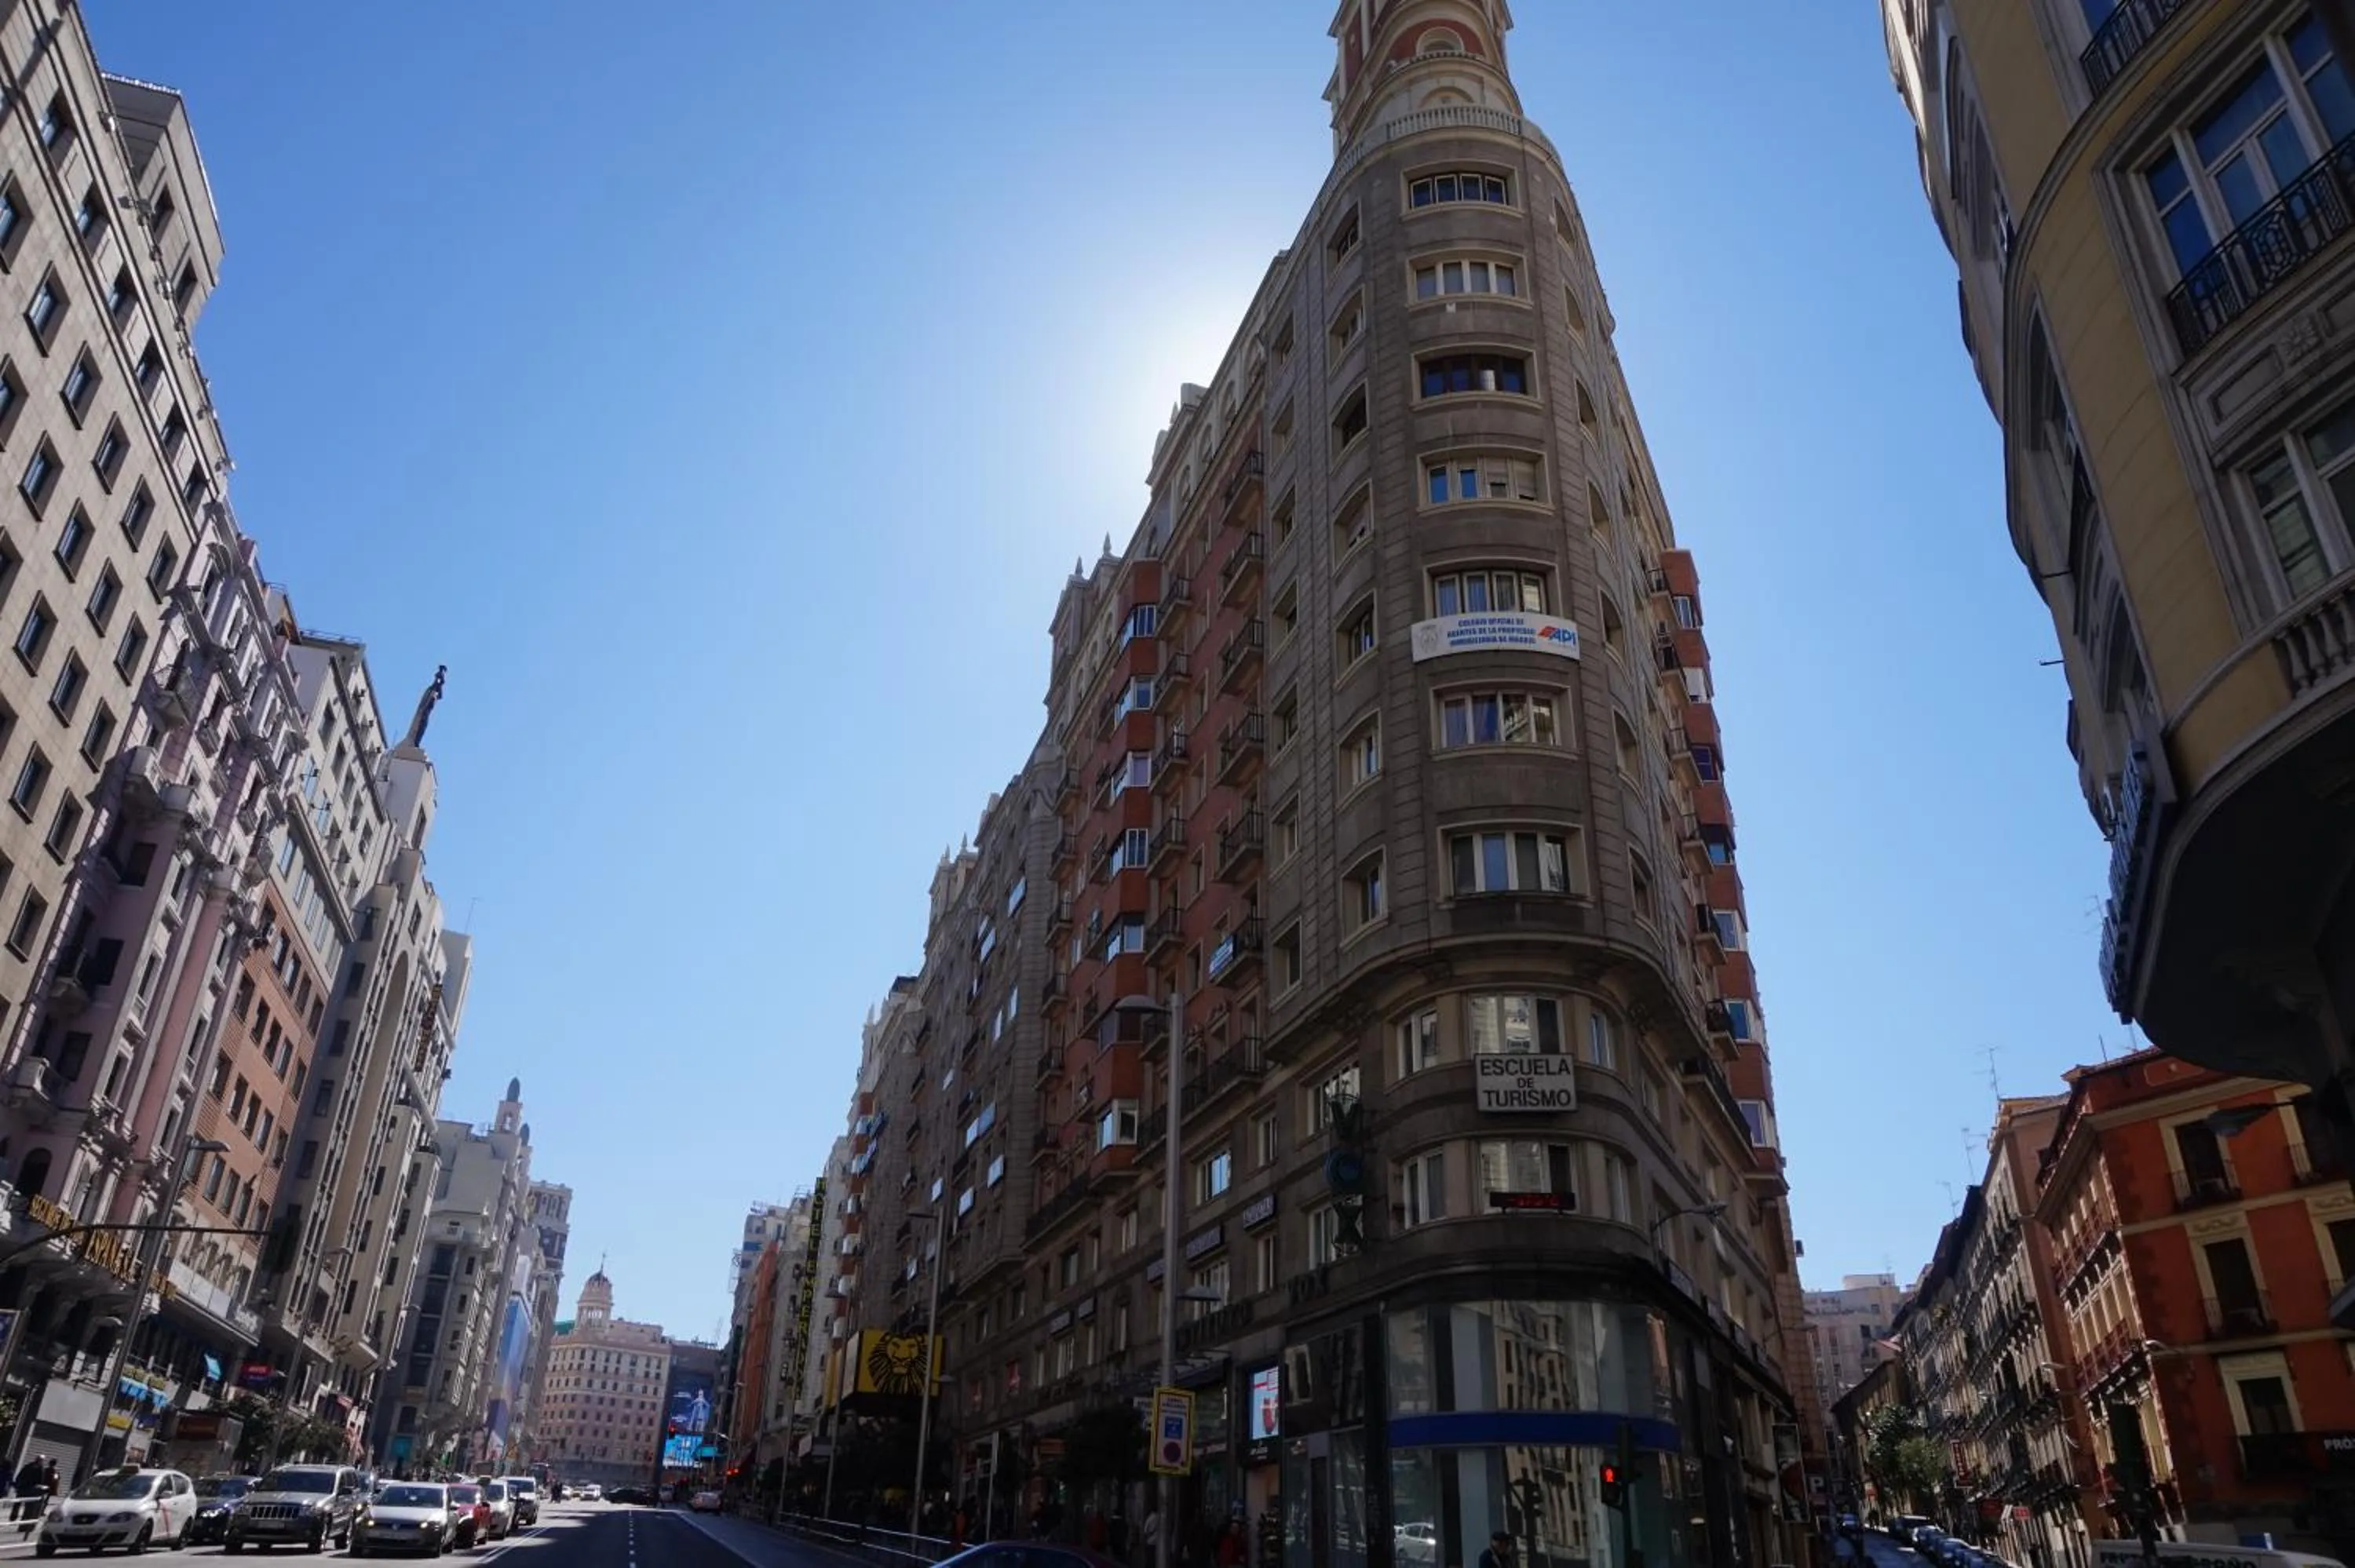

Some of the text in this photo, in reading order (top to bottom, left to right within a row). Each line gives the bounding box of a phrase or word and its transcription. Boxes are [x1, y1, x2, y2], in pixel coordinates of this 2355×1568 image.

[1481, 1058, 1571, 1076] ESCUELA
[1517, 1078, 1534, 1088] DE
[1483, 1089, 1571, 1107] TURISMO
